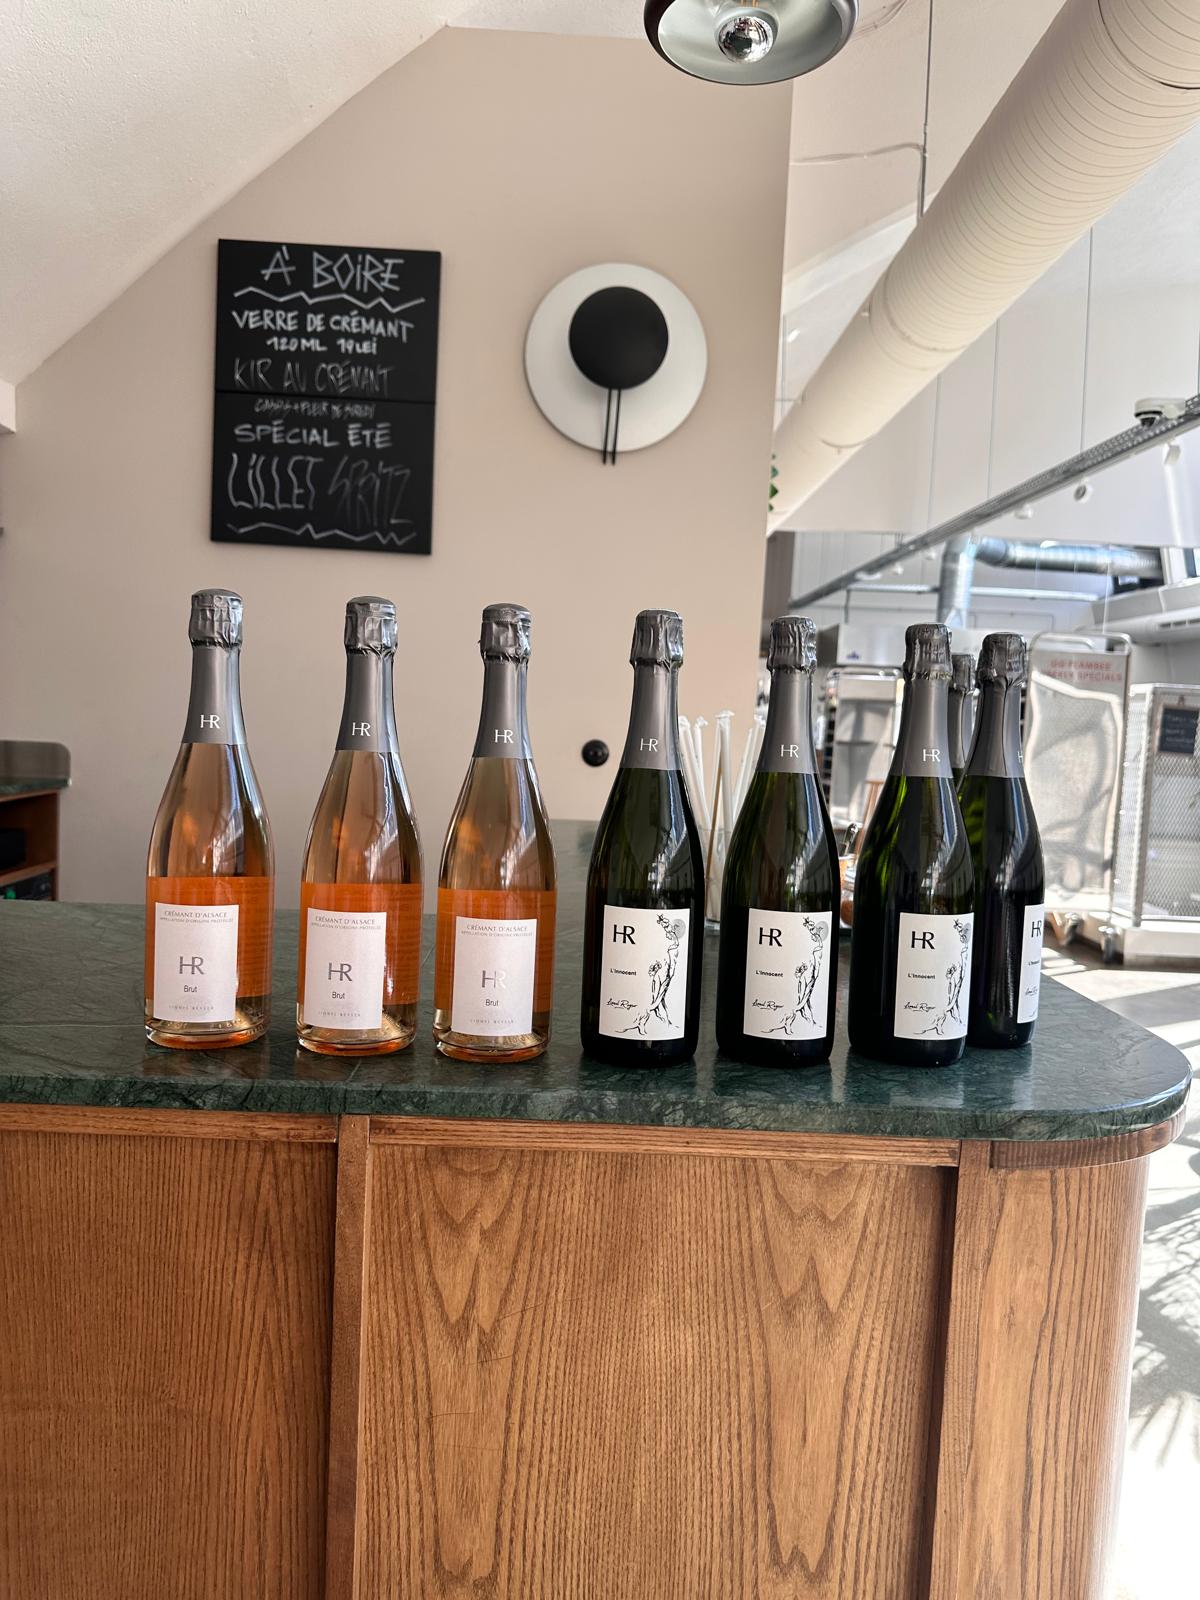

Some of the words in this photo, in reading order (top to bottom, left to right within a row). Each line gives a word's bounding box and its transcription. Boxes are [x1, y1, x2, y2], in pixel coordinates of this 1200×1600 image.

[232, 310, 299, 330] VERRE
[306, 312, 326, 332] DE
[329, 310, 415, 343] CRÉMANT
[233, 358, 272, 391] KIR
[234, 420, 340, 448] SPÉCIAL
[348, 422, 392, 448] ÉTÉ
[200, 714, 221, 729] HR
[352, 722, 371, 737] HR
[494, 729, 514, 744] HR
[640, 738, 658, 752] HR
[780, 744, 799, 758] HR
[923, 748, 941, 762] HR
[612, 924, 636, 944] HR
[758, 927, 782, 947] HR
[1031, 920, 1042, 938] HR
[911, 930, 935, 950] HR
[179, 956, 204, 975] HR
[327, 962, 352, 982] HR
[481, 970, 506, 989] HR
[184, 985, 197, 993] Brut
[332, 991, 345, 999] Brut
[485, 998, 499, 1007] Brut
